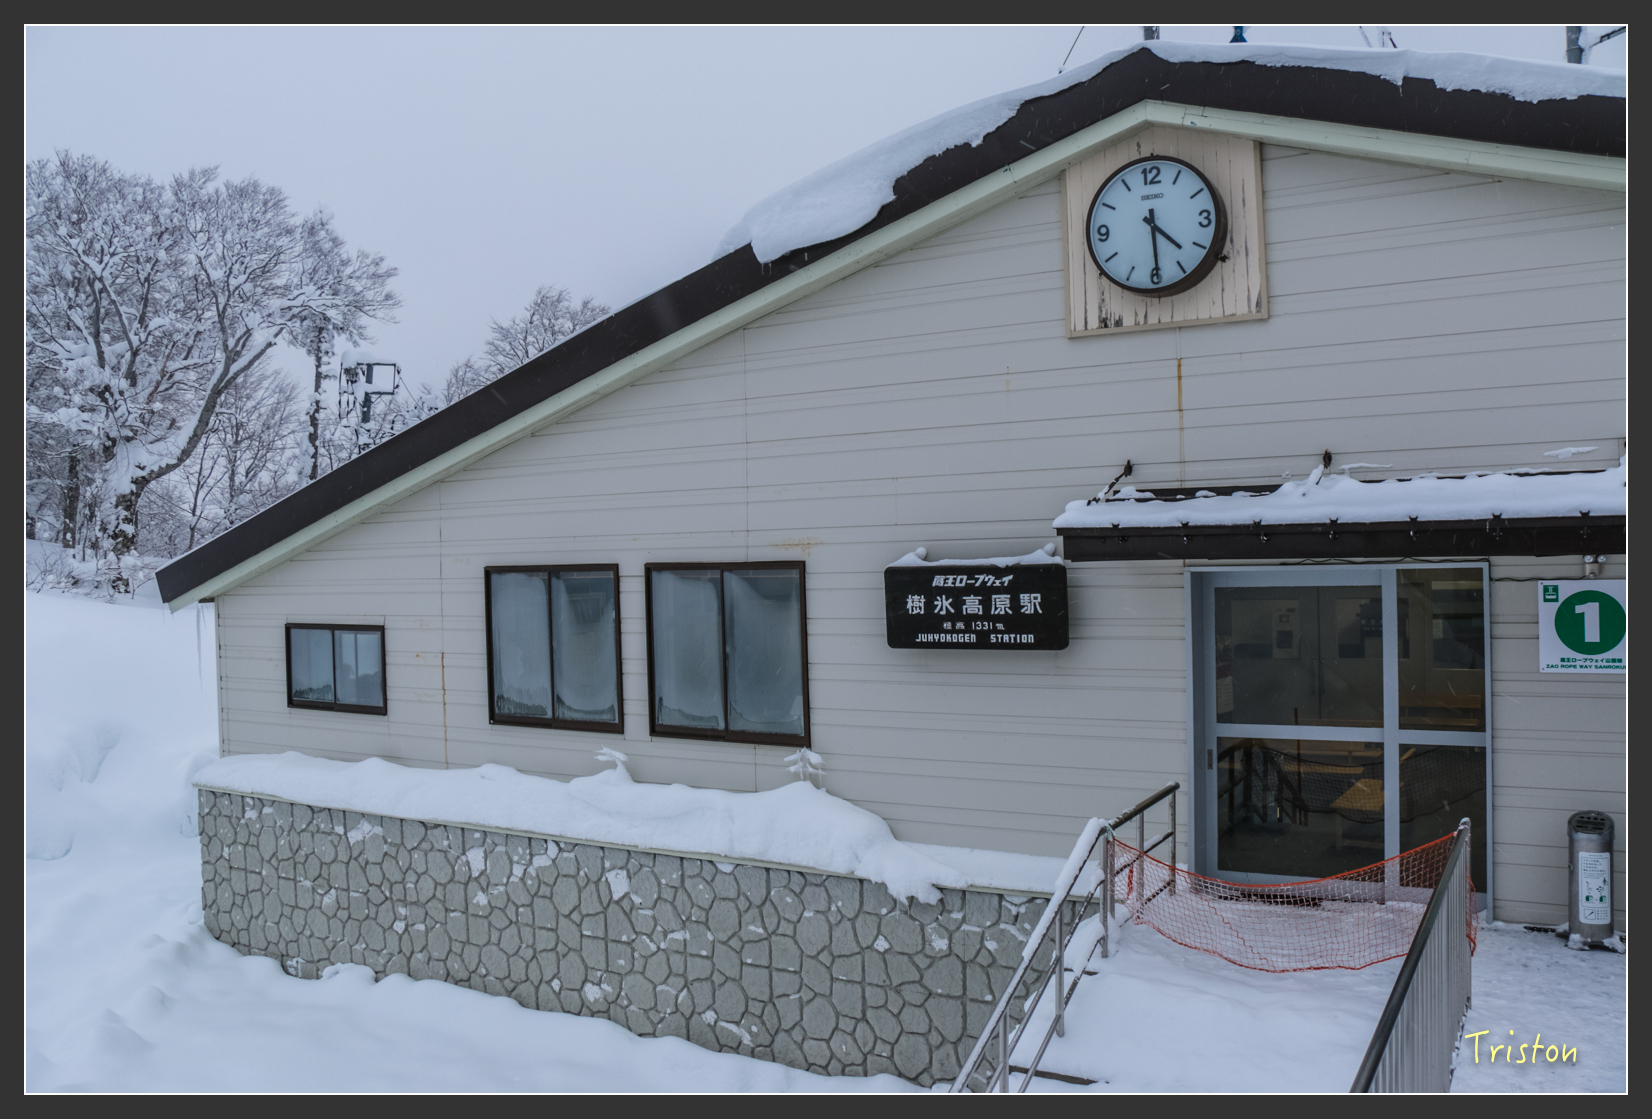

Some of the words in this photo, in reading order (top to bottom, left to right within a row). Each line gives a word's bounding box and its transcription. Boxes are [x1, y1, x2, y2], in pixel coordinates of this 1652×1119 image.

[1140, 165, 1162, 186] 12
[1140, 192, 1165, 201] SEIKO
[1198, 209, 1212, 228] 3
[1096, 224, 1110, 242] 9
[1150, 266, 1162, 285] 6
[932, 574, 1014, 587] 蔵王ロープウェイ
[906, 593, 1043, 615] 樹氷高原駅
[1574, 602, 1600, 643] 1
[915, 633, 977, 643] JUHYOKOGEN
[990, 634, 1035, 643] STATION
